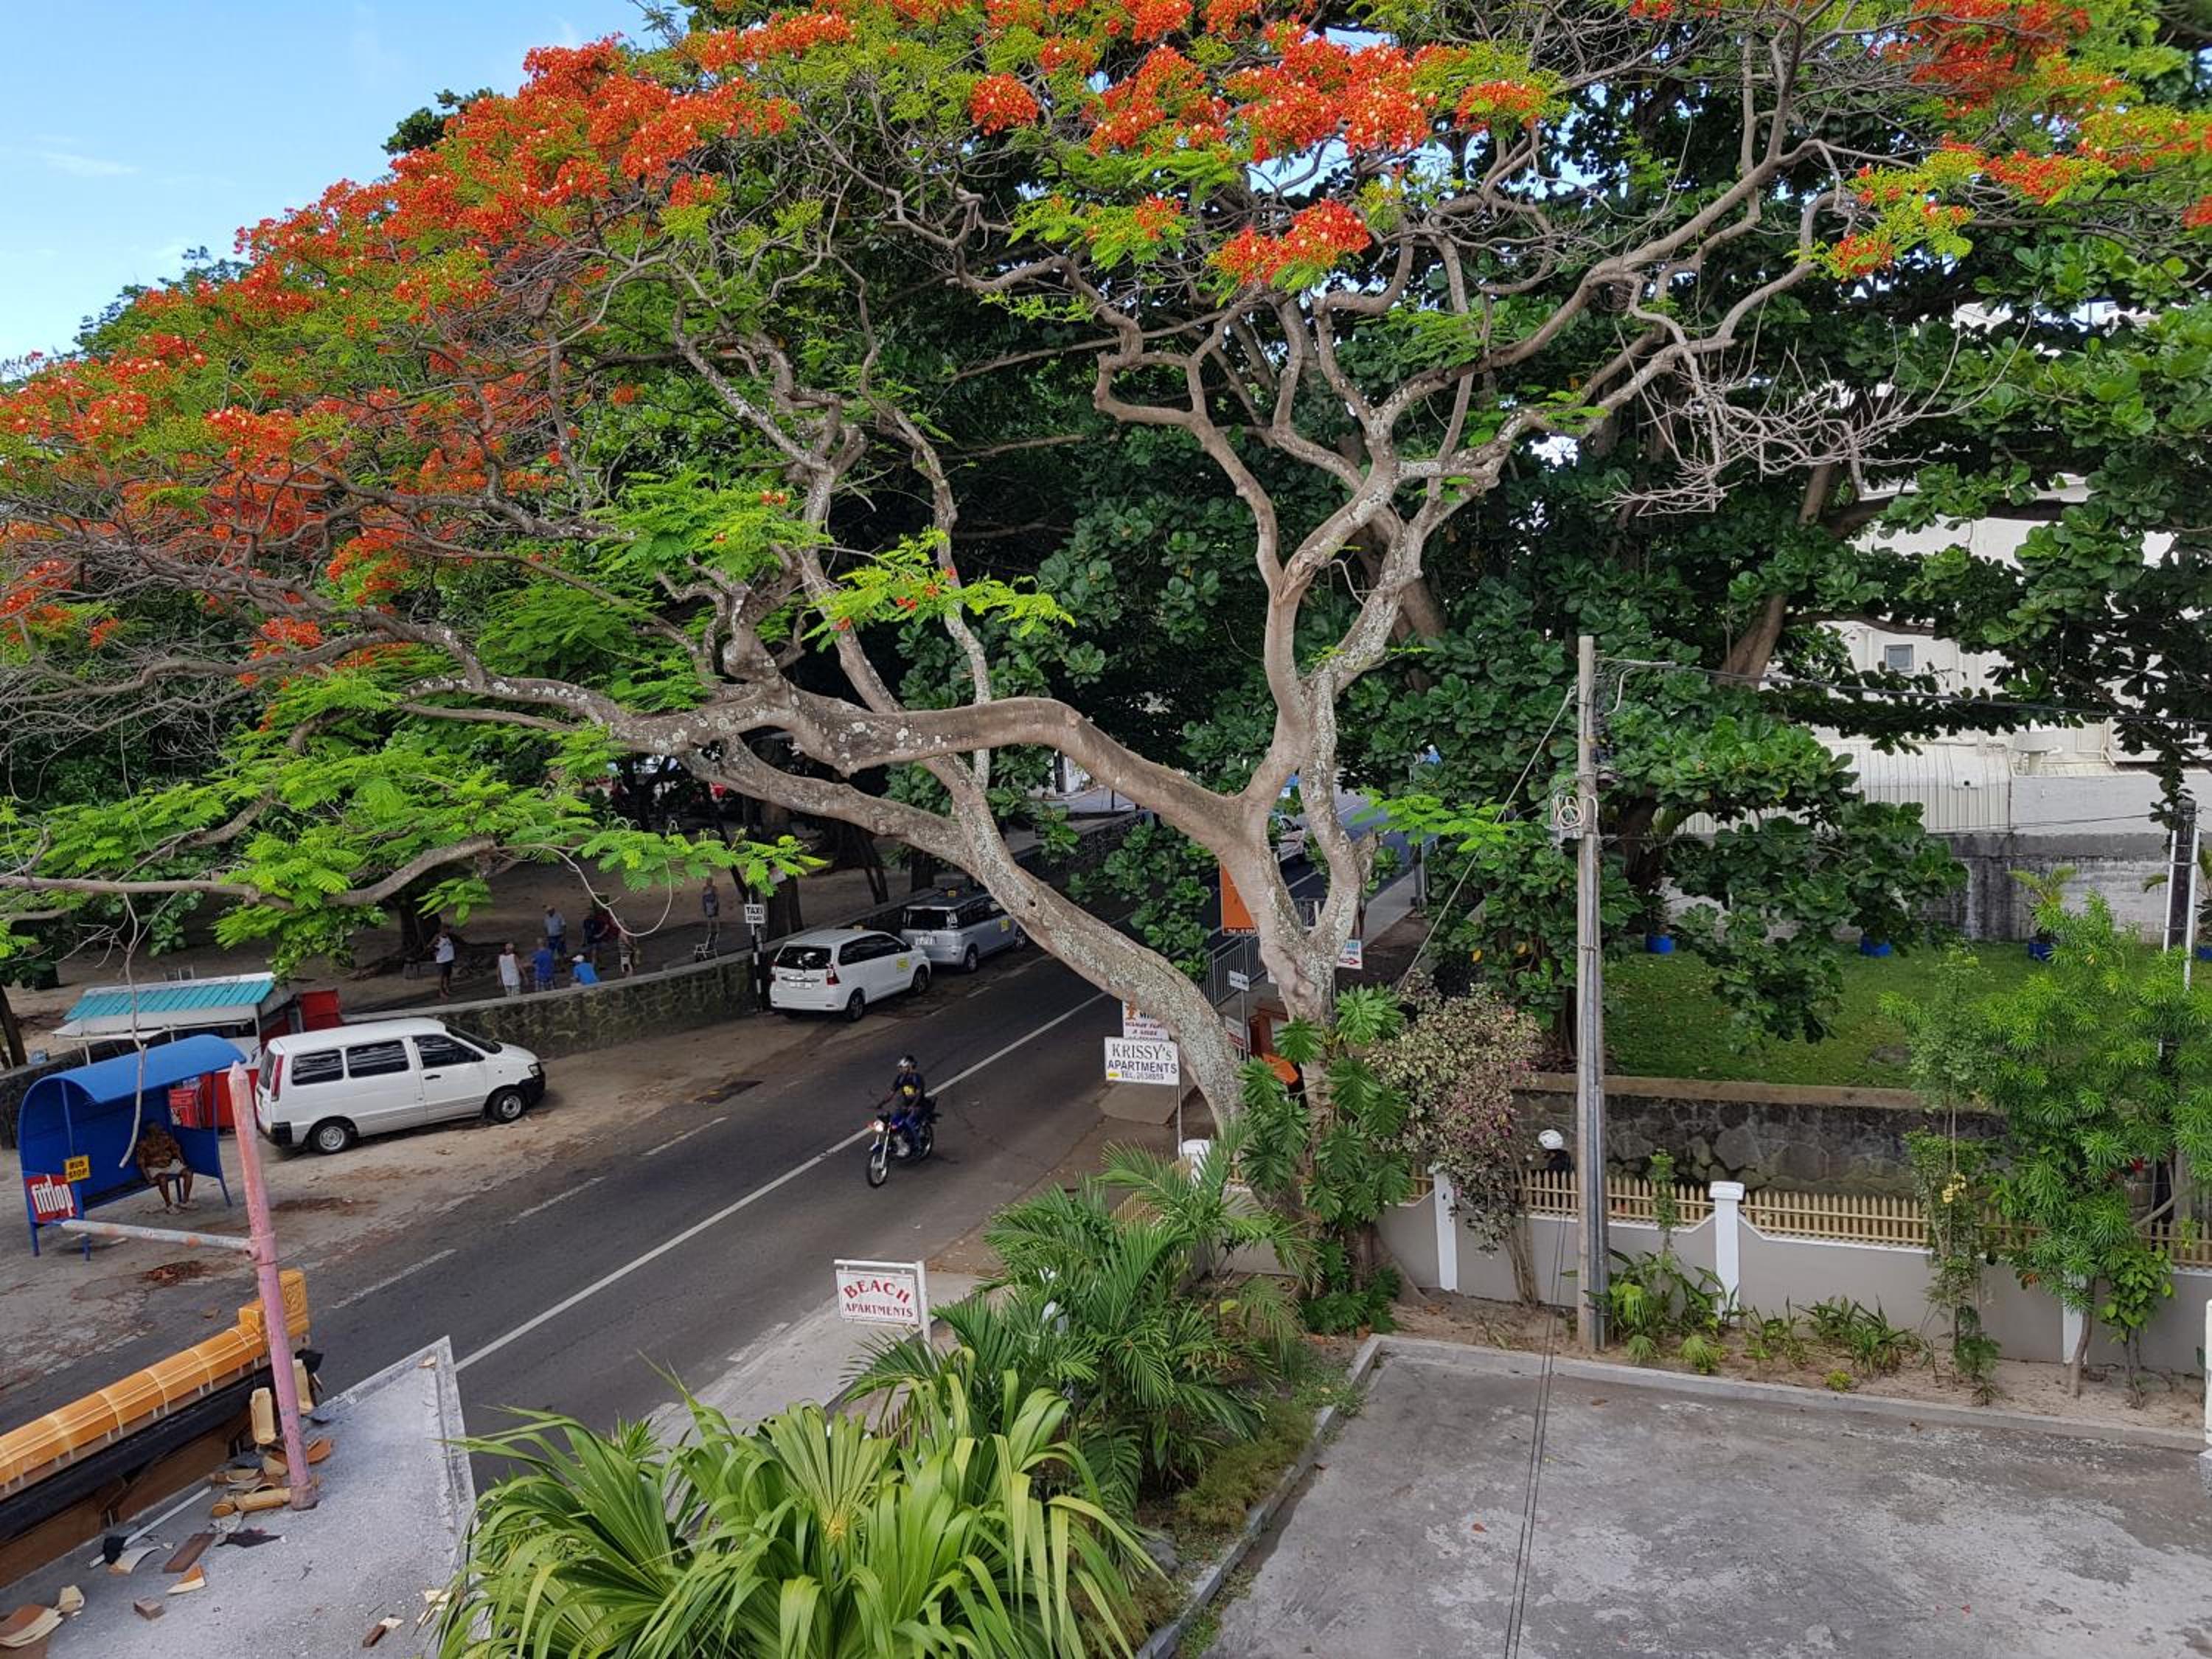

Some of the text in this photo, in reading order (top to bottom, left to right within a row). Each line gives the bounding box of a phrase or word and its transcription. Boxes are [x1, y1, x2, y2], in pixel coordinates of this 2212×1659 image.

[746, 906, 763, 914] TAXI
[1107, 1060, 1178, 1074] APARTMENTS
[69, 1160, 85, 1170] BUS
[69, 1168, 88, 1179] STOP
[844, 1279, 911, 1304] BEACH
[844, 1303, 914, 1318] APARTMENTS
